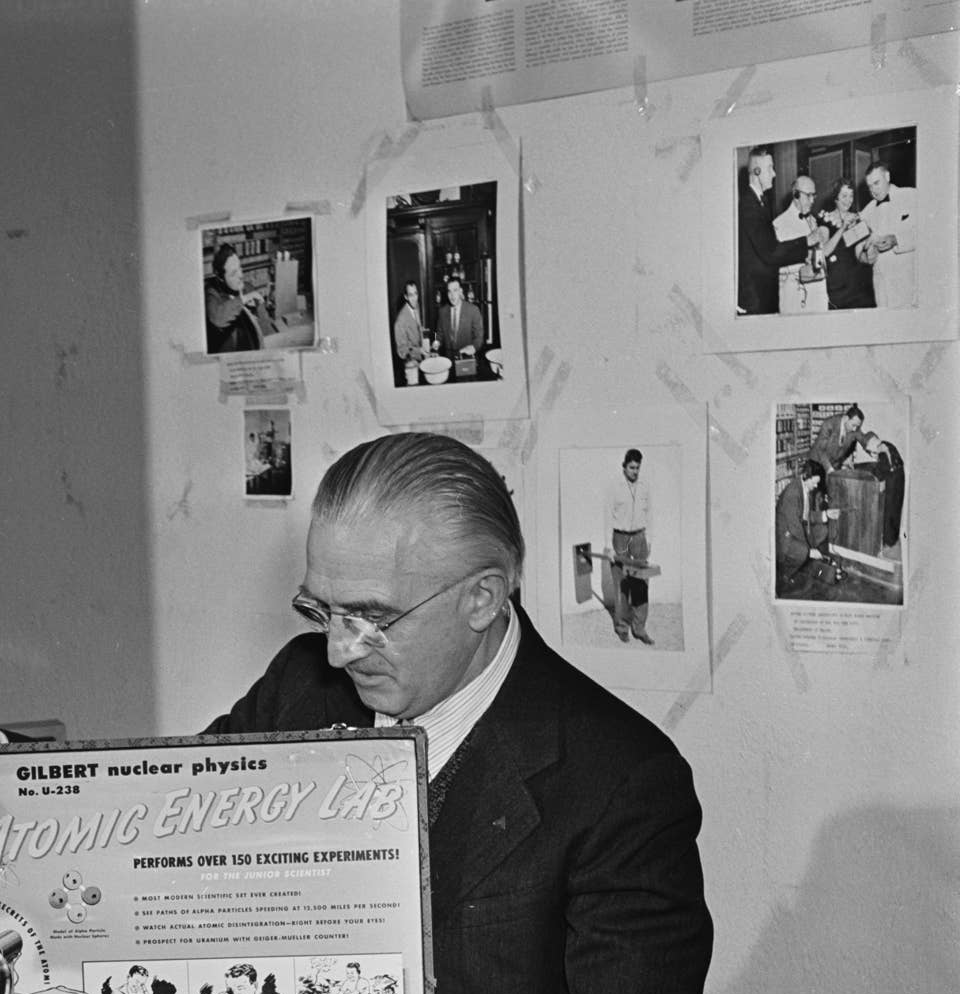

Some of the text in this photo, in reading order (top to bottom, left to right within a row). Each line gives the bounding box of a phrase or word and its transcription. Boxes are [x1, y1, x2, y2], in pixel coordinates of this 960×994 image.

[16, 756, 268, 782] GILBERT nuclear physics
[18, 785, 81, 797] No. U-238
[152, 779, 318, 839] ENERGY
[318, 774, 405, 822] LAB
[133, 848, 401, 870] PERFORMS OVER 150 EXCITING EXPERIMENTS!
[223, 870, 242, 880] THE
[244, 869, 282, 880] JUNIOR
[284, 867, 333, 879] SCIENTIST
